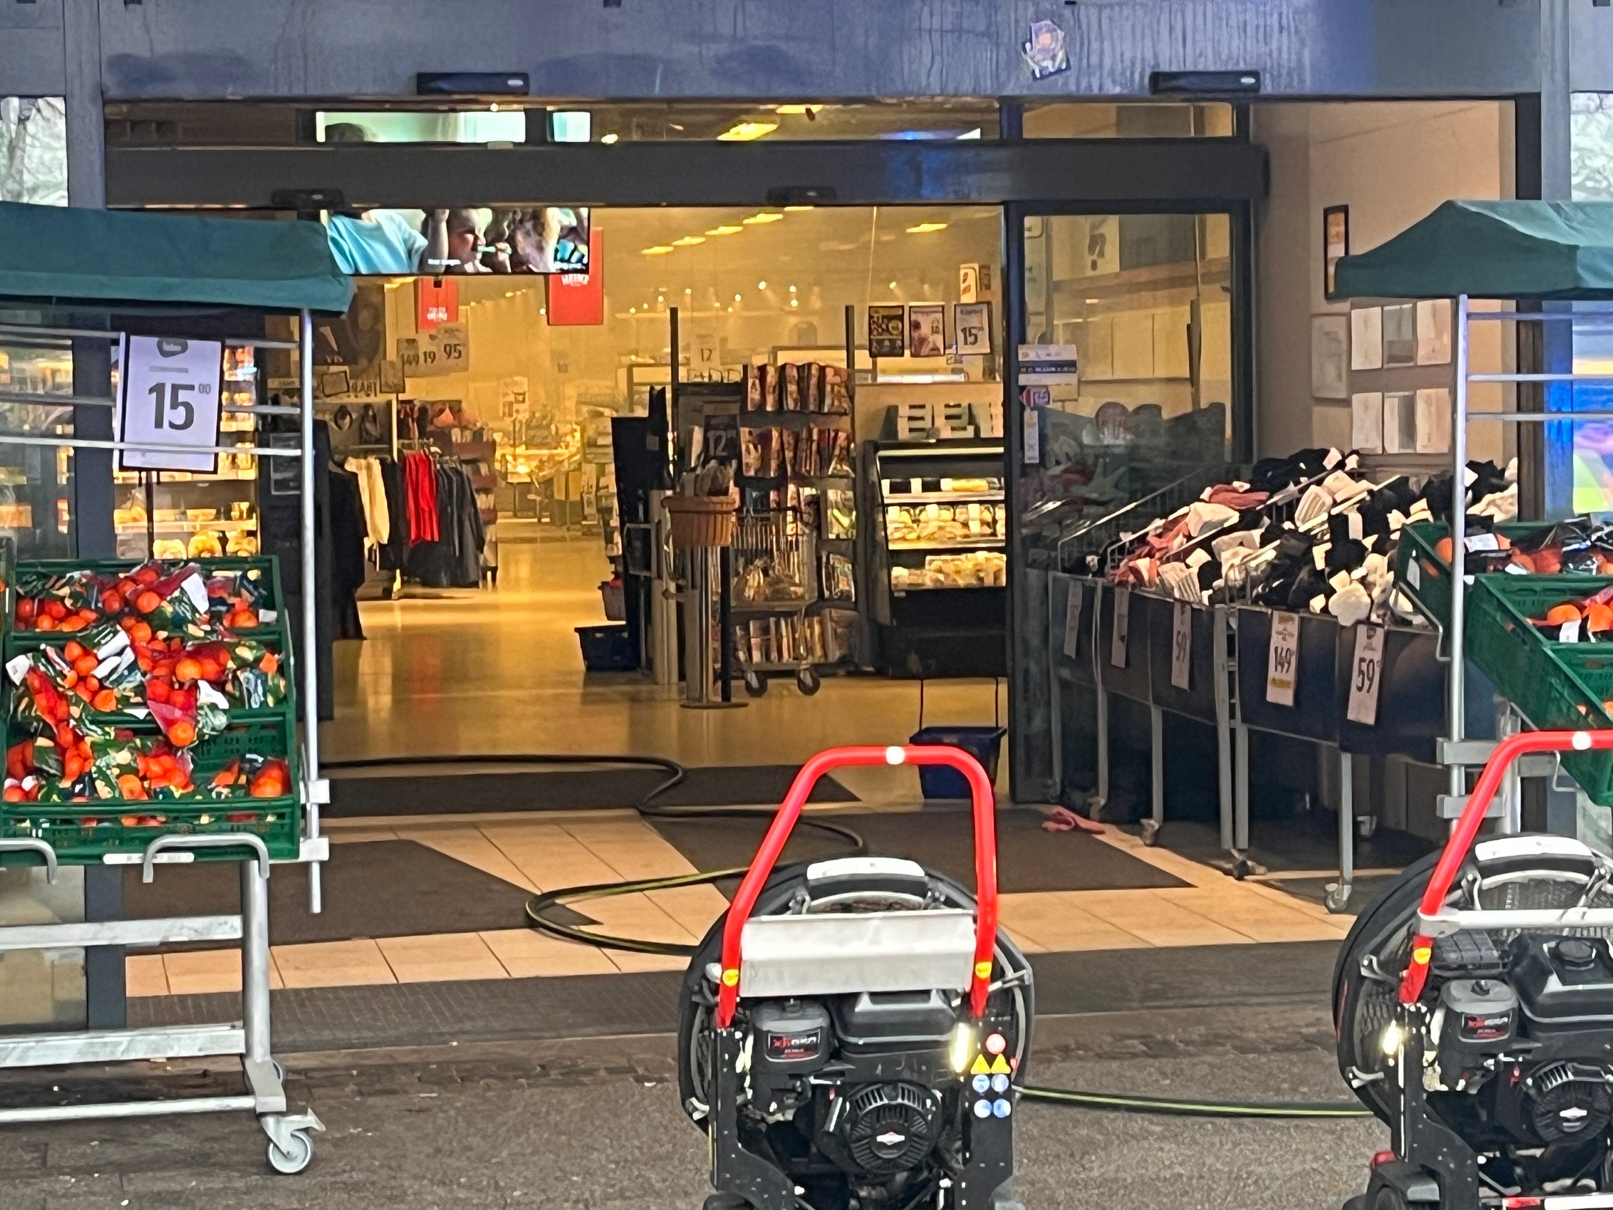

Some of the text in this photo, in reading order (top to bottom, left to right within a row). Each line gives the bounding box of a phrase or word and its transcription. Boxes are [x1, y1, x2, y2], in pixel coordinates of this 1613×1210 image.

[960, 326, 979, 346] 15
[423, 350, 436, 364] 19
[443, 343, 462, 360] 95
[148, 382, 196, 431] 15
[1274, 646, 1292, 673] 149
[1356, 657, 1375, 693] 59
